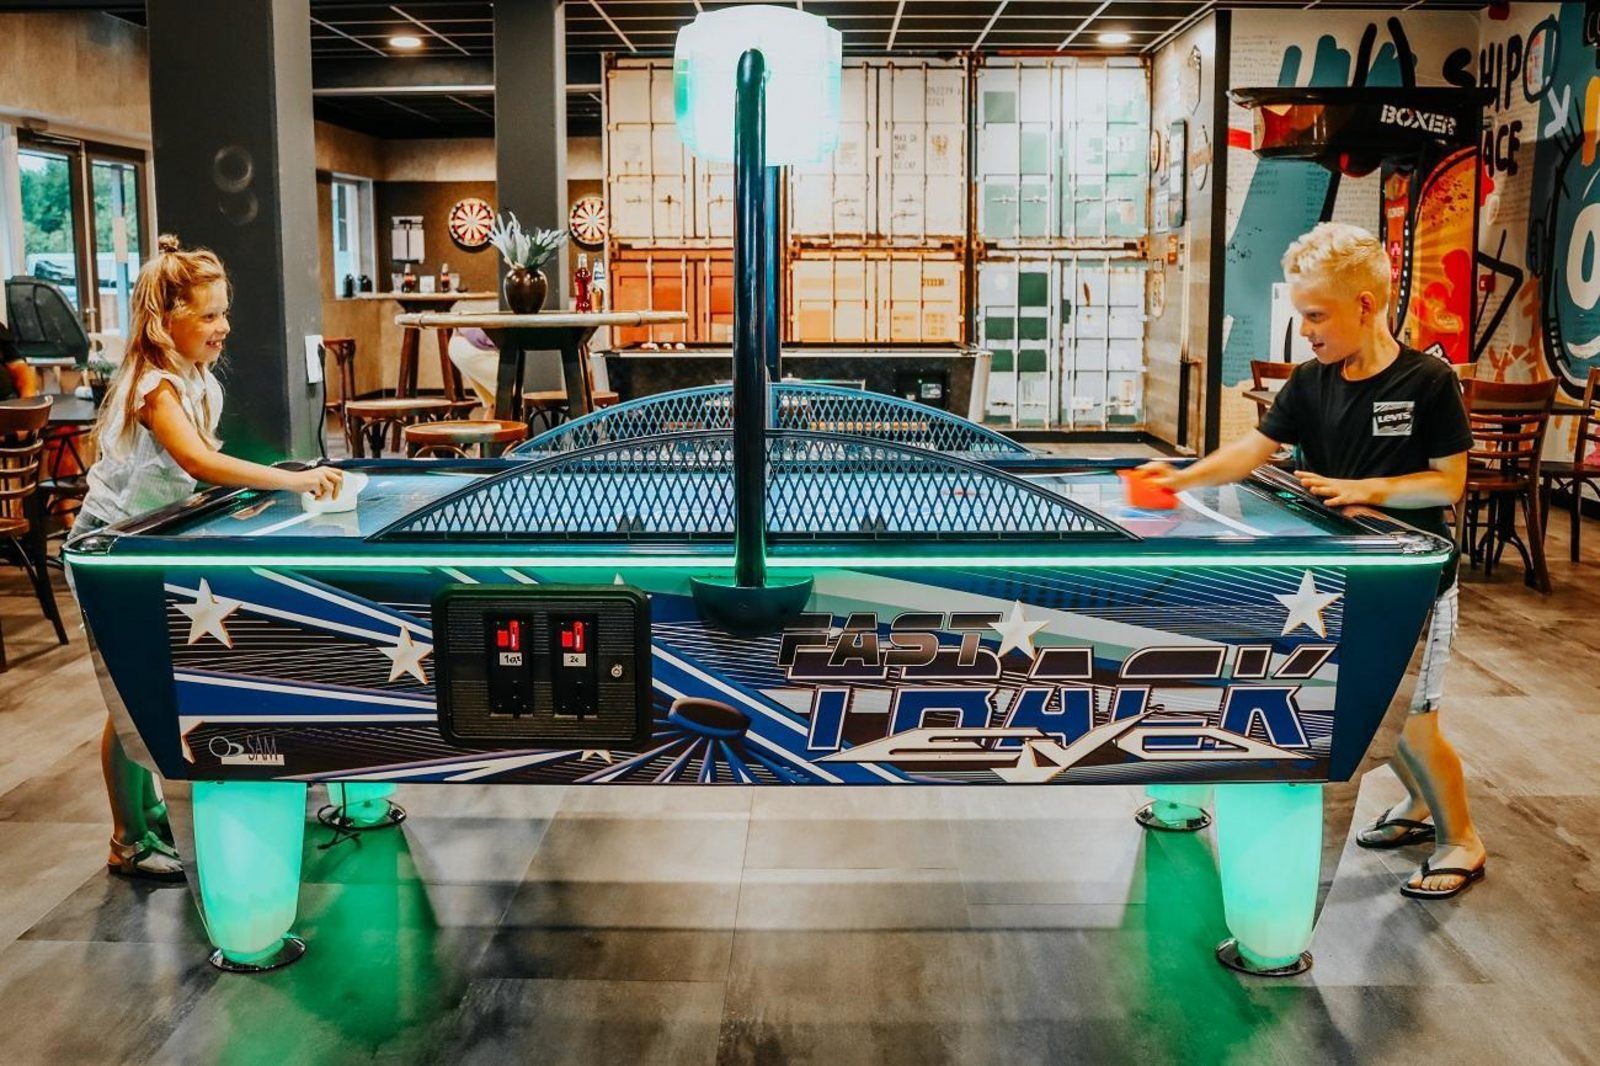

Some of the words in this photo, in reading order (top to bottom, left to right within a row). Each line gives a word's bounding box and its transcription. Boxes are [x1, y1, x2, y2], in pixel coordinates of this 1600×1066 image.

[1380, 104, 1457, 136] BOXER
[1481, 120, 1523, 178] ACE
[777, 612, 1004, 667] FAST
[786, 644, 1338, 752] TRACK
[246, 734, 278, 761] SAM
